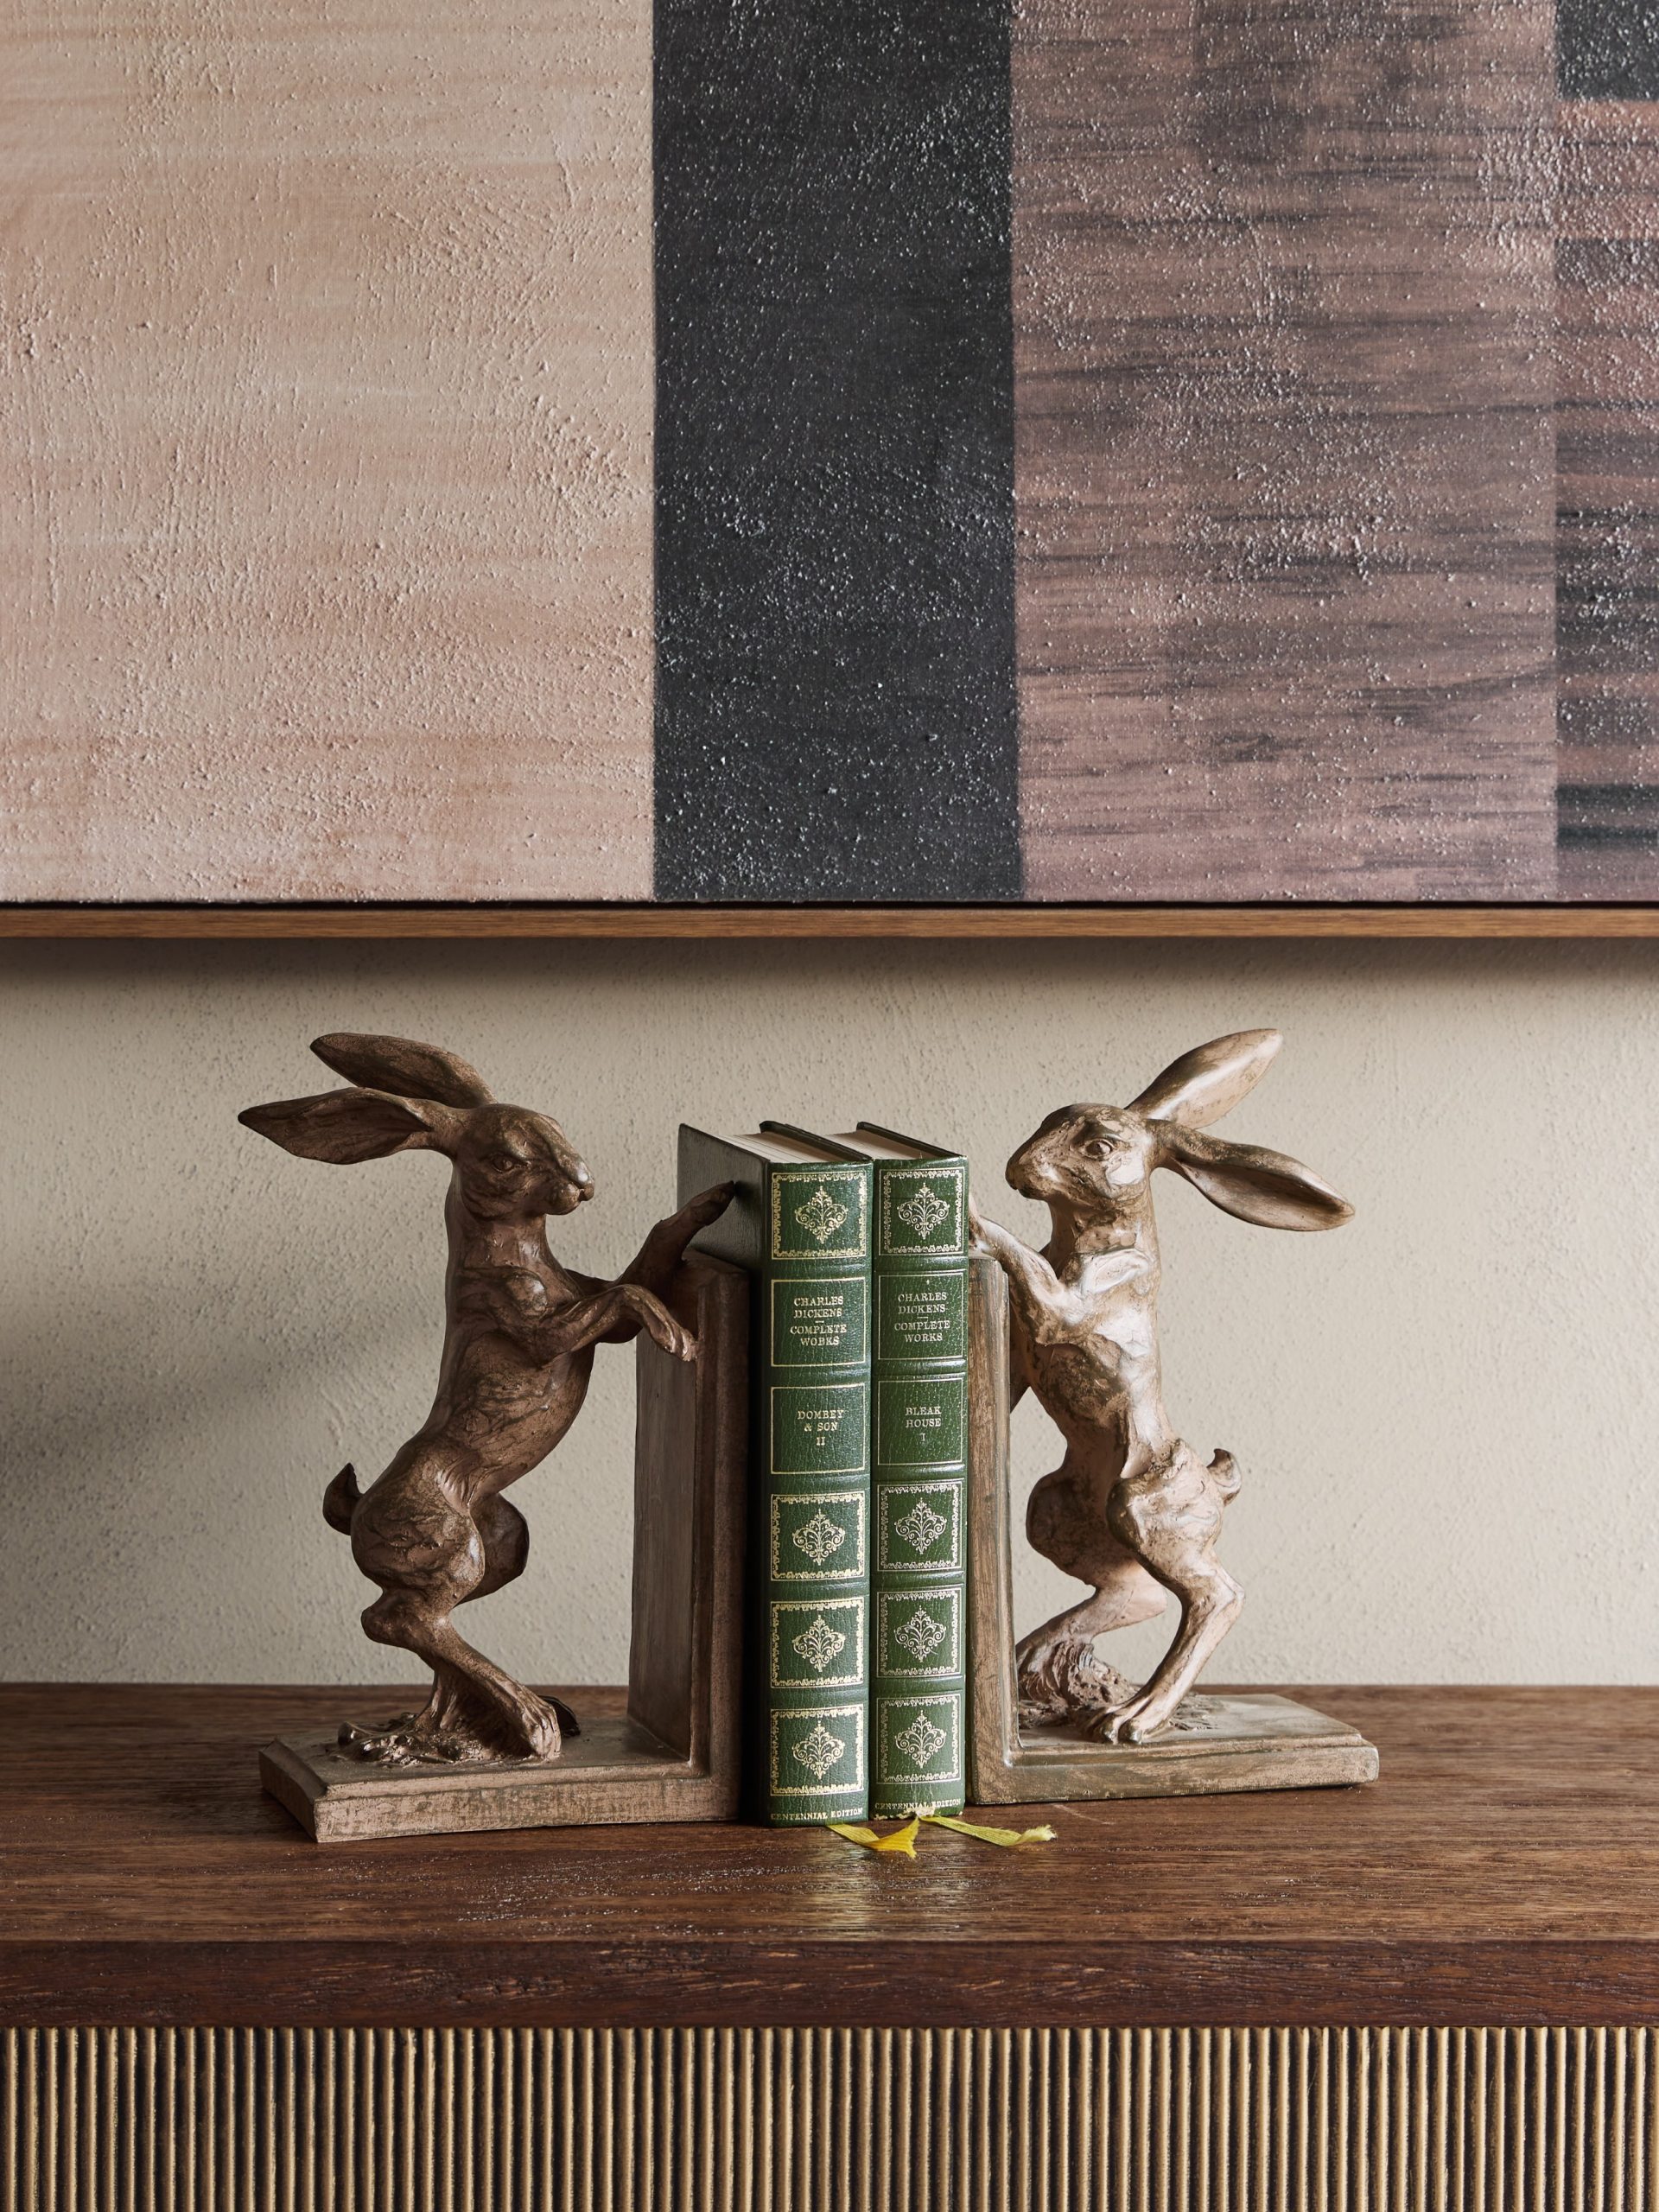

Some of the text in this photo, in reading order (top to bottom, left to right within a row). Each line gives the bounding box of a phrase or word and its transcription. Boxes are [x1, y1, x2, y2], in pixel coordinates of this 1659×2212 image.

[794, 1295, 843, 1306] CHARLES
[898, 1292, 948, 1302] CHARLES
[793, 1308, 842, 1319] DICKENS
[898, 1303, 946, 1314] DICKENS
[790, 1324, 847, 1335] COMPLETE
[894, 1320, 950, 1331] COMPLETE
[800, 1336, 840, 1346] WORKS
[905, 1332, 943, 1343] WORKS
[798, 1409, 844, 1420] DOMBEY
[906, 1406, 942, 1416] BLEAK
[804, 1421, 838, 1432] & SON
[906, 1417, 942, 1428] HOUSE
[816, 1436, 826, 1446] II
[874, 1798, 962, 1810] CENTENNIAL EDITION
[770, 1808, 863, 1821] CENTENNIAL EDITION
